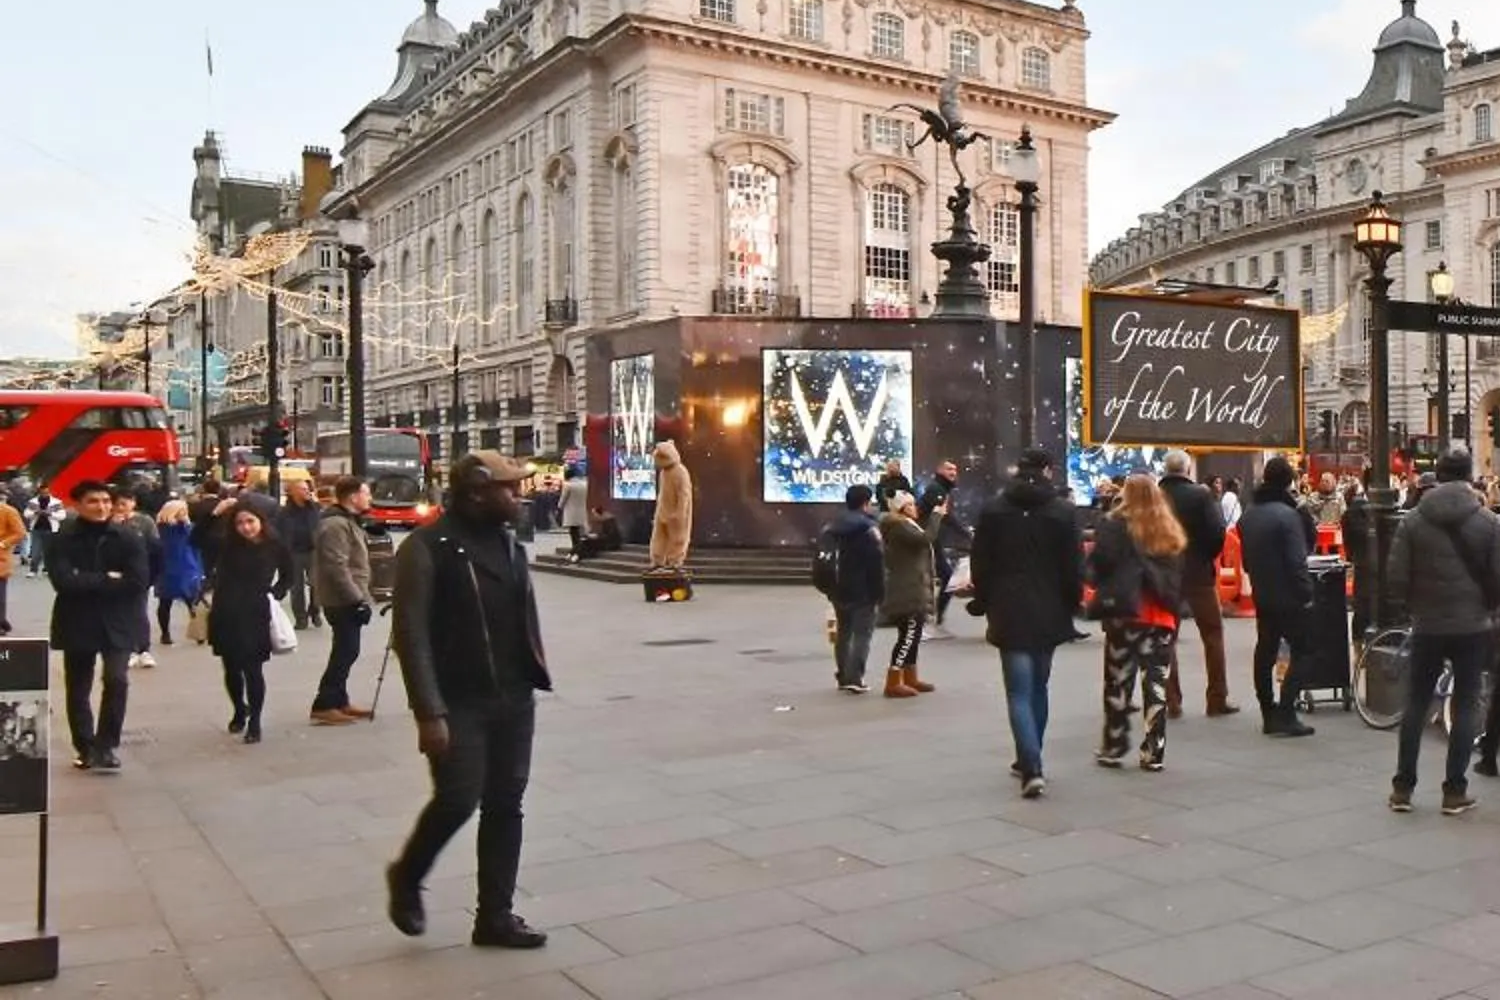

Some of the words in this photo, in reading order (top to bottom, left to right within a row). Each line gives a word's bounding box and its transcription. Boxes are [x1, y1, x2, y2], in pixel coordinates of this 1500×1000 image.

[1108, 311, 1215, 363] Greatest
[1224, 317, 1279, 382] City
[1437, 313, 1470, 325] PUBLIC
[619, 375, 654, 458] W
[791, 368, 887, 459] W
[1080, 363, 1152, 458] of
[1138, 365, 1185, 421] the
[1185, 374, 1285, 429] World
